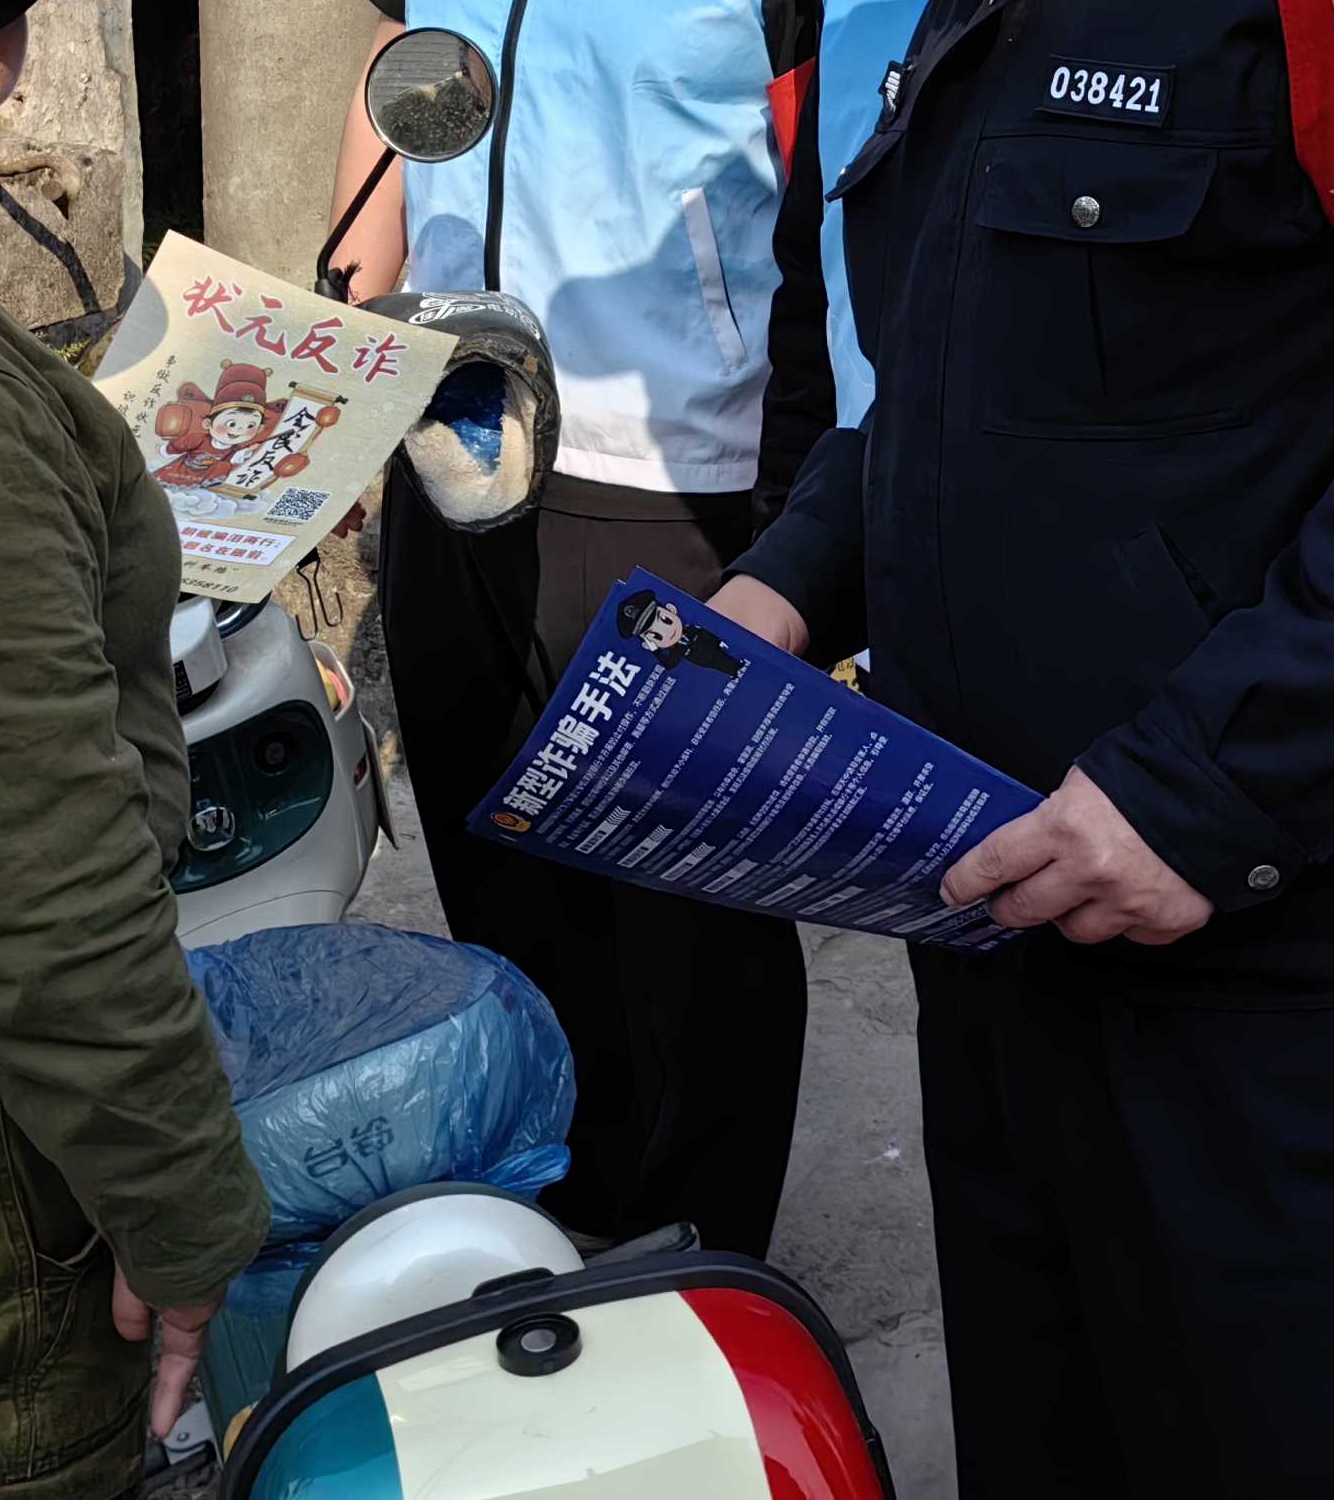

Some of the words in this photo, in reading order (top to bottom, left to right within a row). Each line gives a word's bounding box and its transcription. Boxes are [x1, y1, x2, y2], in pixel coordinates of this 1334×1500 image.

[1050, 66, 1161, 113] 038421
[183, 275, 409, 383] 状元反诈
[501, 651, 643, 817] 新型诈骗手法
